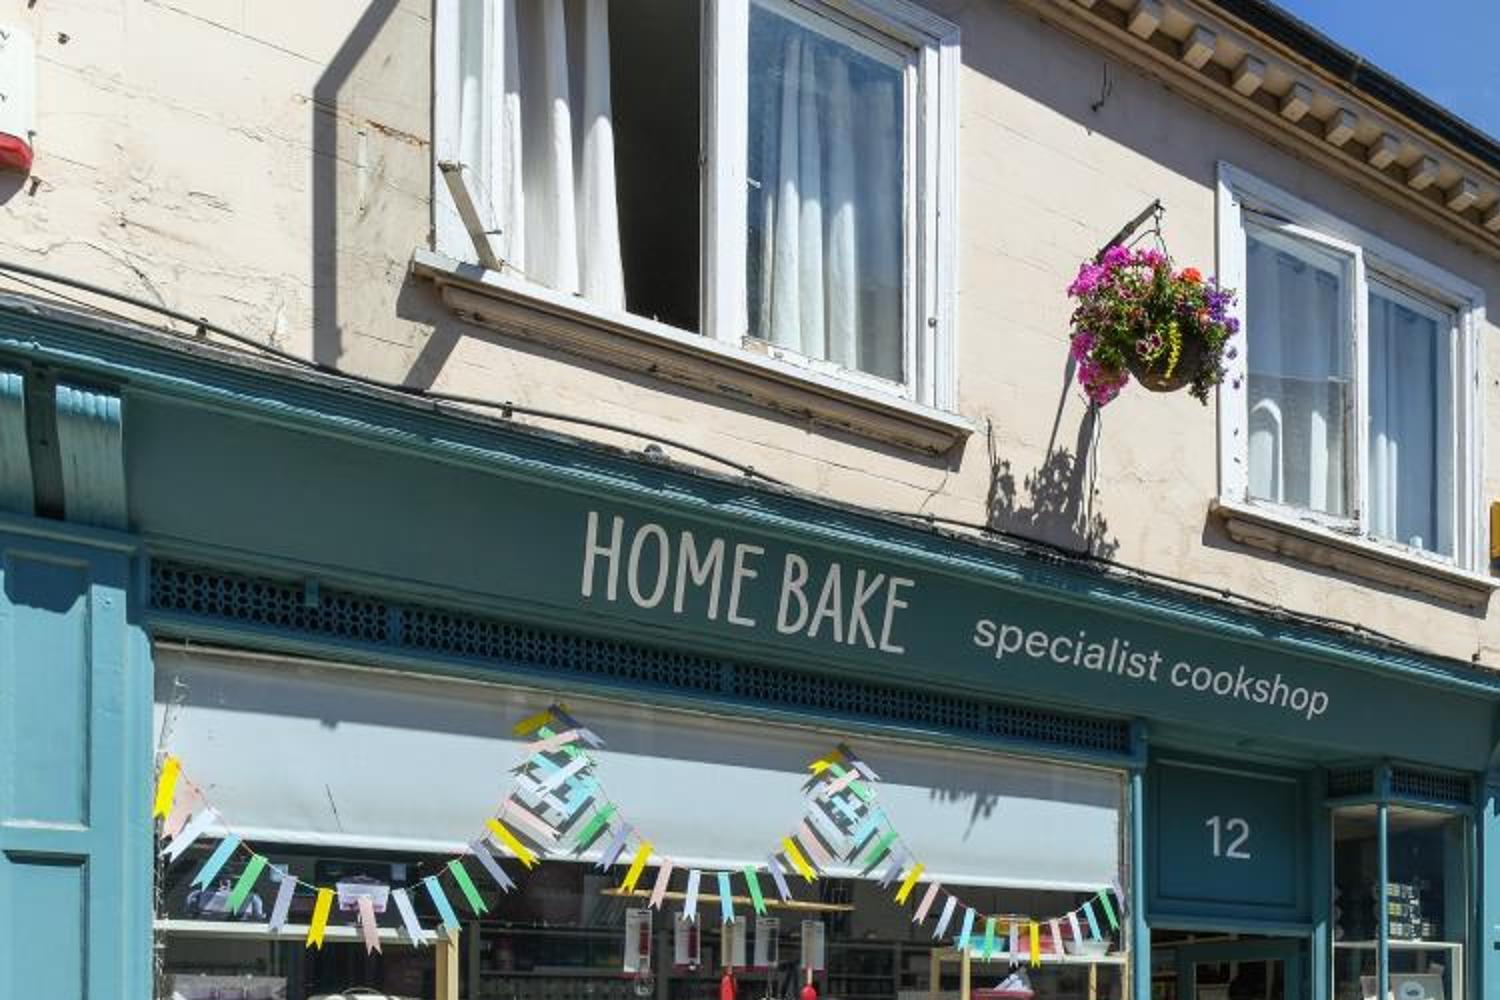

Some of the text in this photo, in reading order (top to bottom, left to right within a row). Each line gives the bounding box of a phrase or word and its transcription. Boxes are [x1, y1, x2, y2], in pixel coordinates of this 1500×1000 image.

[580, 511, 916, 654] HOME BAKE
[973, 618, 1330, 720] specialist cookshop
[1205, 815, 1251, 859] 12
